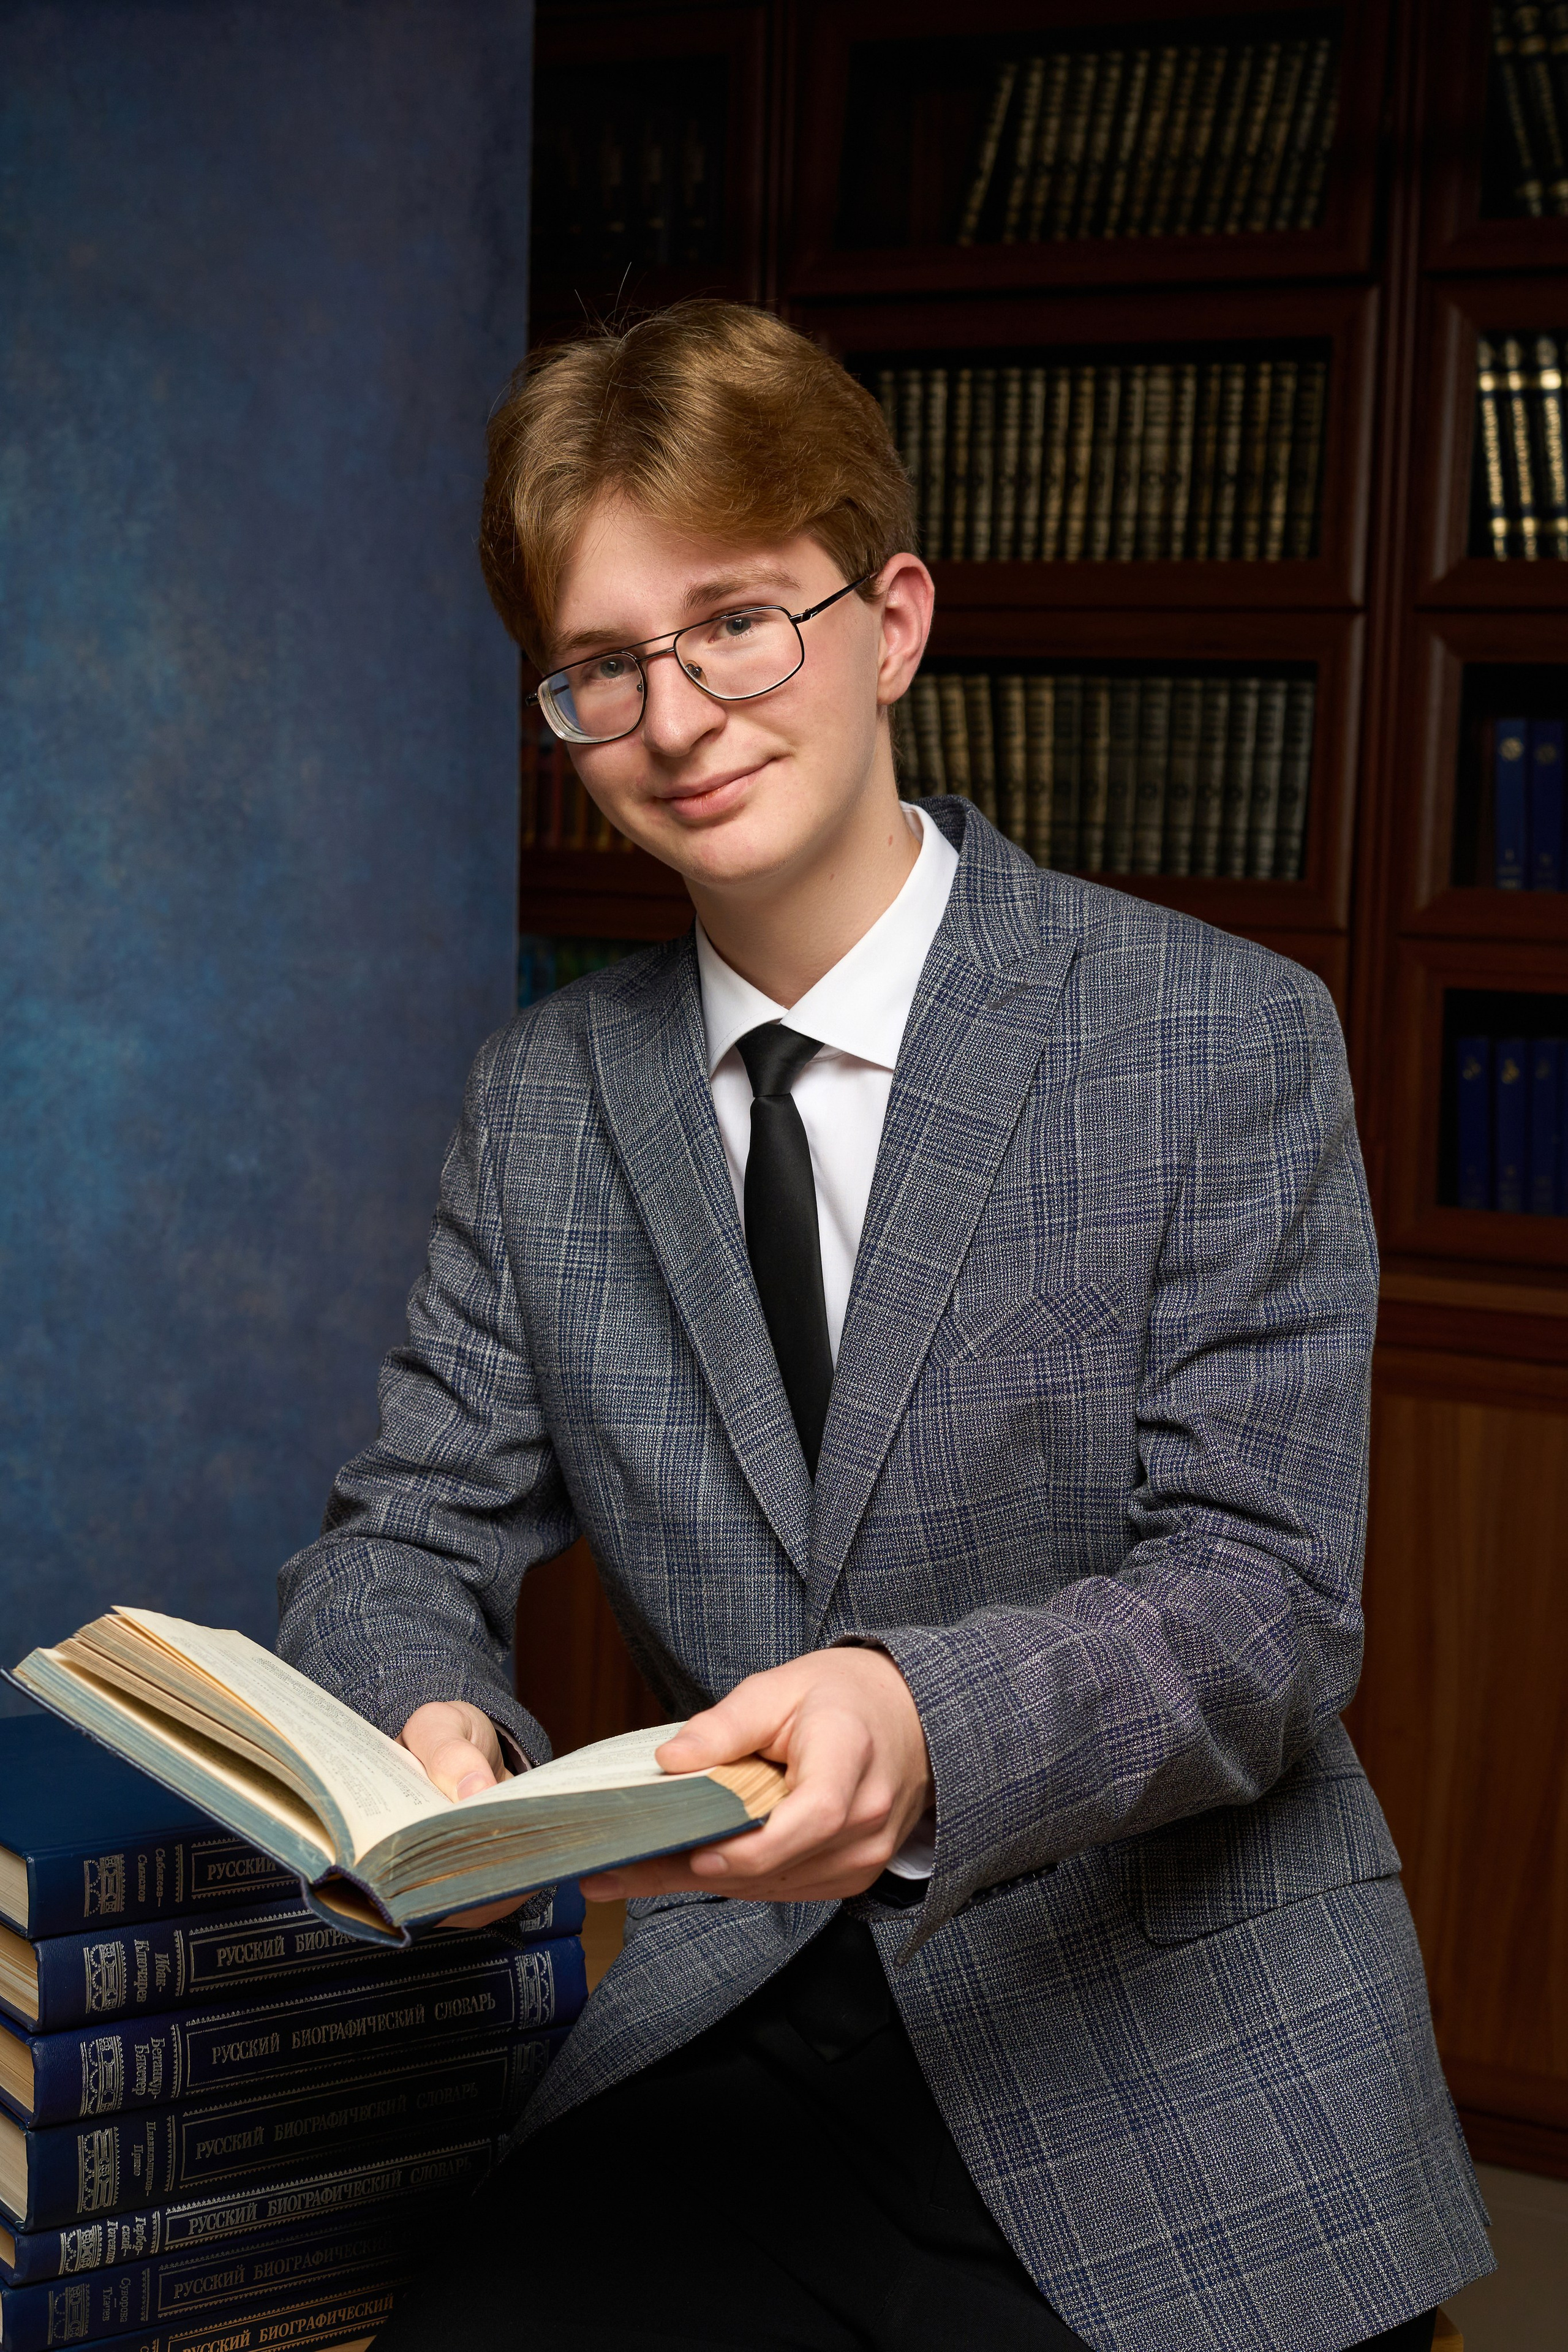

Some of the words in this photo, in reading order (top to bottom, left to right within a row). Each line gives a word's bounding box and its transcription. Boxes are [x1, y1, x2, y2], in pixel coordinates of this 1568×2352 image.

[134, 1939, 150, 2003] Ключарев
[216, 1934, 285, 1967] РУССКИЙ
[211, 2032, 281, 2065] РУССКИЙ
[291, 2003, 426, 2049] БИОГРАФИЧЕСКИЙ
[434, 1992, 496, 2021] СЛОВАРЬ
[132, 2043, 150, 2095] Бякстер
[195, 2125, 265, 2160] РУССКИЙ
[274, 2094, 407, 2143] БИОГРАФИЧЕСКИЙ
[416, 2082, 479, 2110] СЛОВАРЬ
[188, 2201, 257, 2236] РУССКИЙ
[266, 2168, 402, 2217] БИОГРАФИЧЕСКИЙ
[410, 2156, 472, 2184] СЛОВАРЬ
[105, 2219, 119, 2264] Гогенлоэ
[102, 2286, 113, 2322] Ткачев
[119, 2277, 131, 2323] Суворова
[173, 2264, 246, 2299] РУССКИЙ
[259, 2292, 394, 2343] БИОГРАФИЧЕСКИЙ
